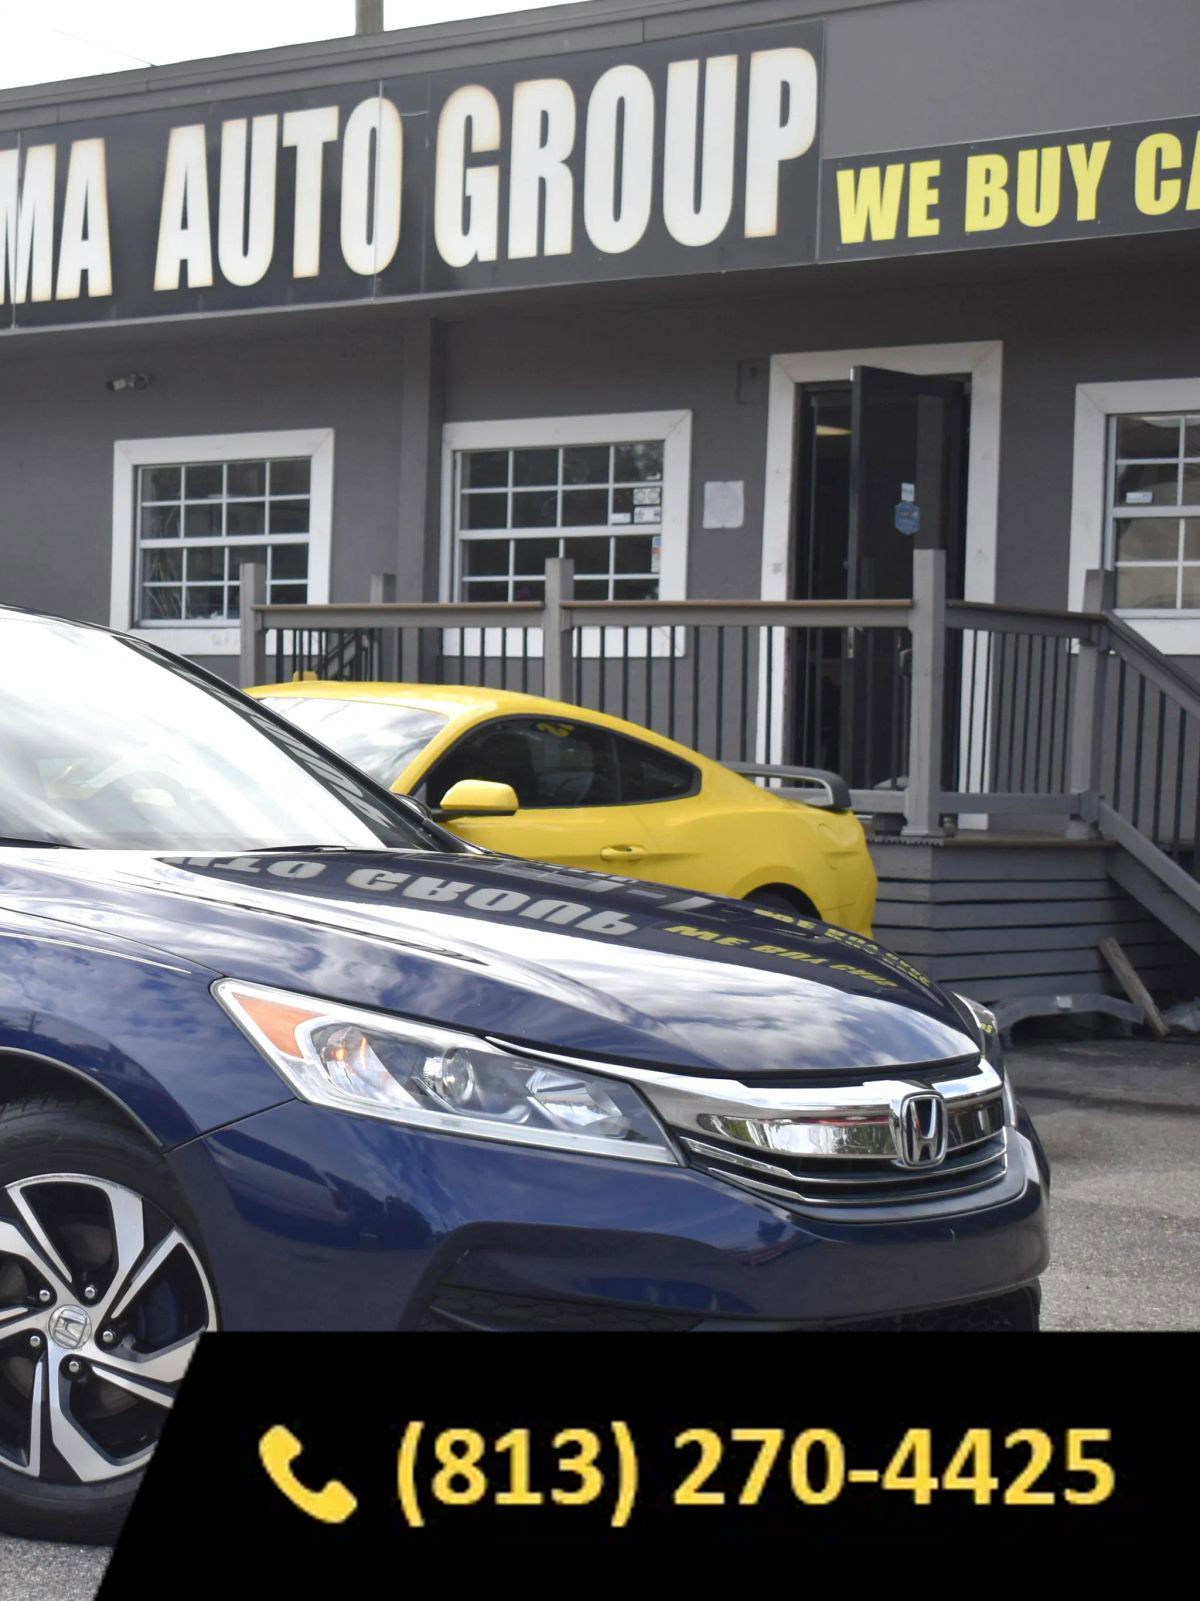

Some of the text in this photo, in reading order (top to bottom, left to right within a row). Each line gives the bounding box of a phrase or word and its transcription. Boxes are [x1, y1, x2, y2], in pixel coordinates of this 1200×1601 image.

[153, 96, 403, 292] AUTO
[432, 46, 818, 267] GROUP
[836, 130, 1200, 244] WE BUY C
